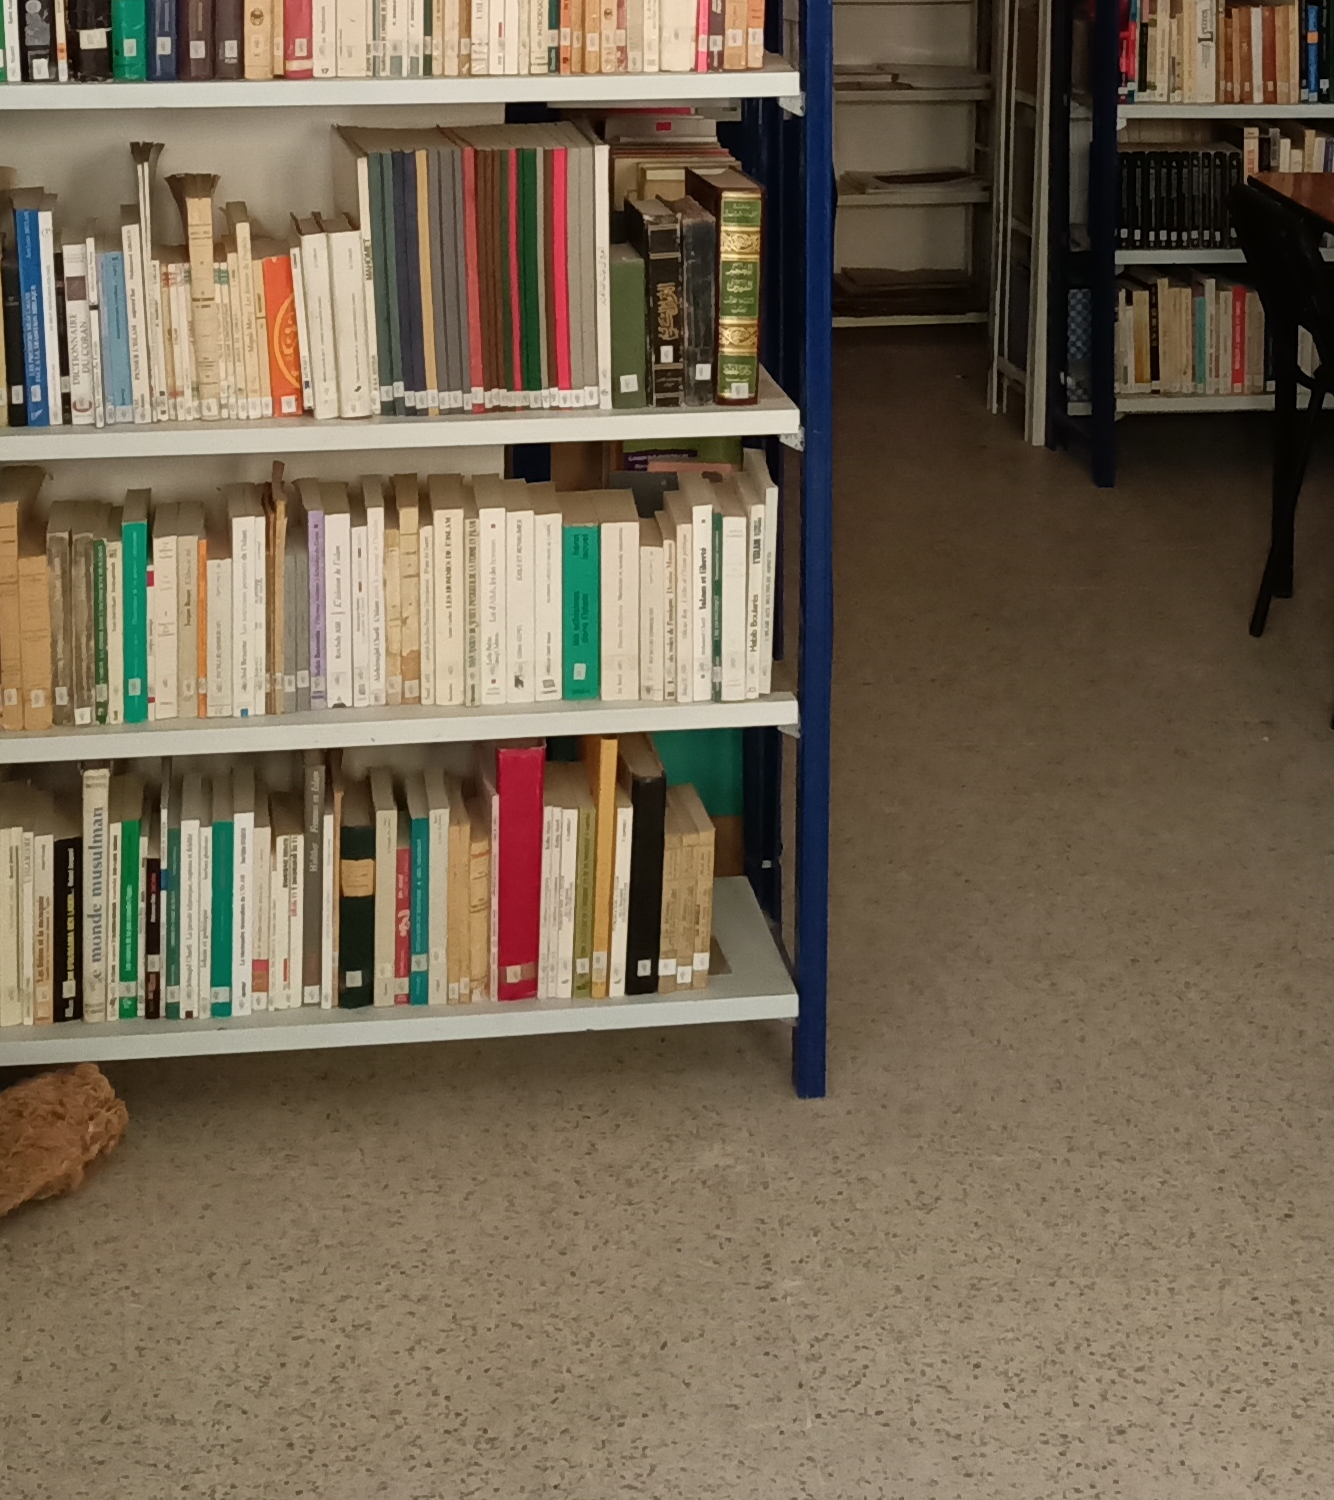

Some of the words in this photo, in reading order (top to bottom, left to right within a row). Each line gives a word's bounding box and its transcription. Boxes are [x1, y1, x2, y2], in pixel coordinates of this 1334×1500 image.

[363, 238, 372, 281] MAHOMET
[69, 314, 80, 385] DICTIONNAIRE
[80, 321, 89, 354] CORAN
[81, 357, 89, 373] DU
[87, 806, 104, 897] musulman
[87, 903, 104, 963] monde
